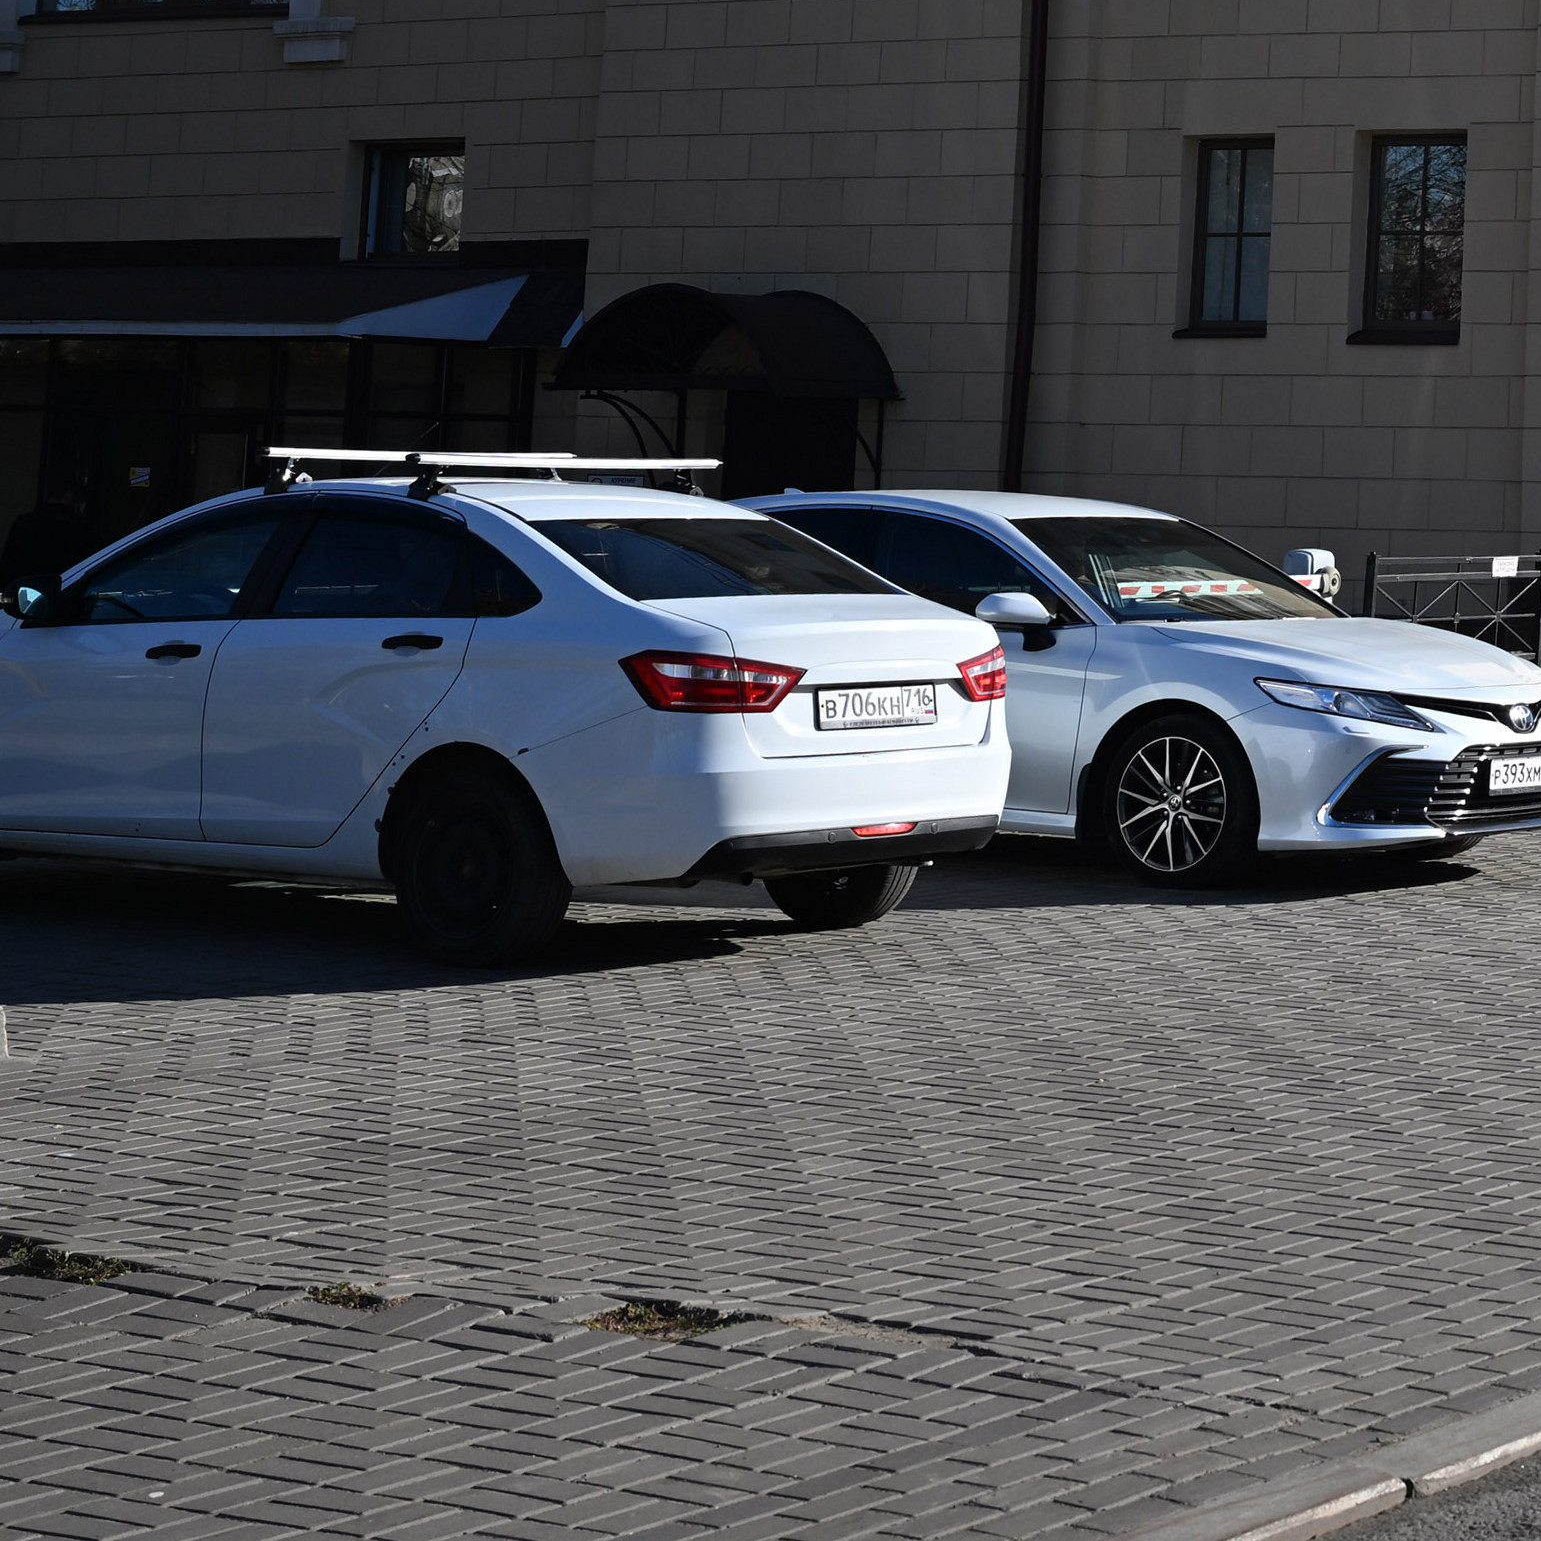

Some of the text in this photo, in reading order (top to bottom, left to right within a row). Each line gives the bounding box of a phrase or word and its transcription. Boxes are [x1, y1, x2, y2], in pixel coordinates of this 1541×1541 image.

[825, 687, 930, 719] В706КН 716
[910, 707, 924, 715] RUS
[1493, 762, 1541, 786] Р393ХМ
